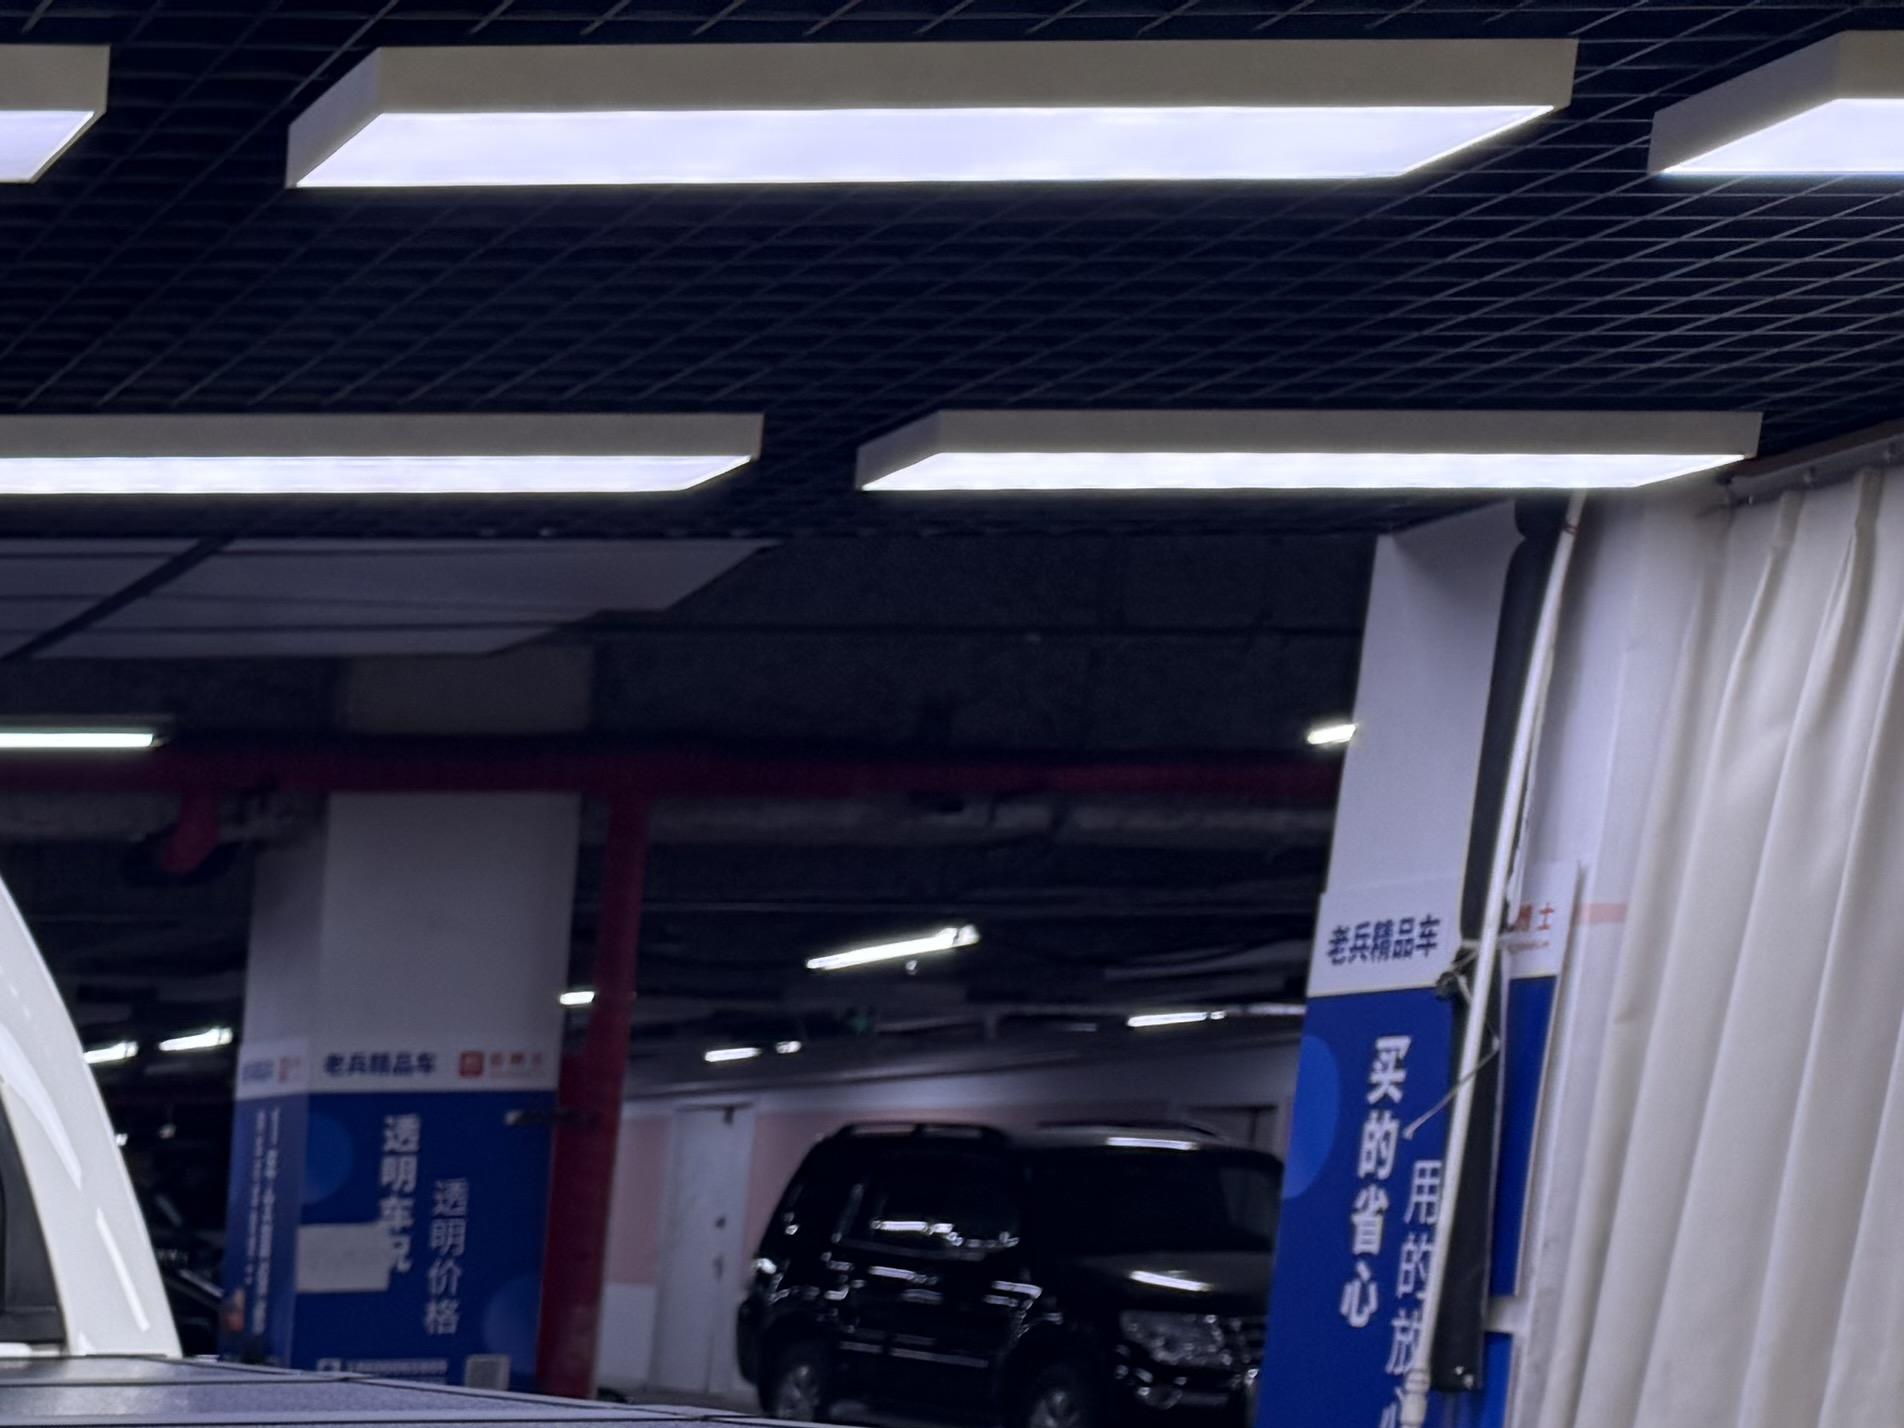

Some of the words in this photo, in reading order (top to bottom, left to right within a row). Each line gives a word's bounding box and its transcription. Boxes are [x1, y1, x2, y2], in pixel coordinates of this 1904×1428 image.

[1327, 914, 1441, 966] 老兵精品车
[423, 1177, 470, 1336] 透明价格
[1340, 1035, 1412, 1328] 买的省心
